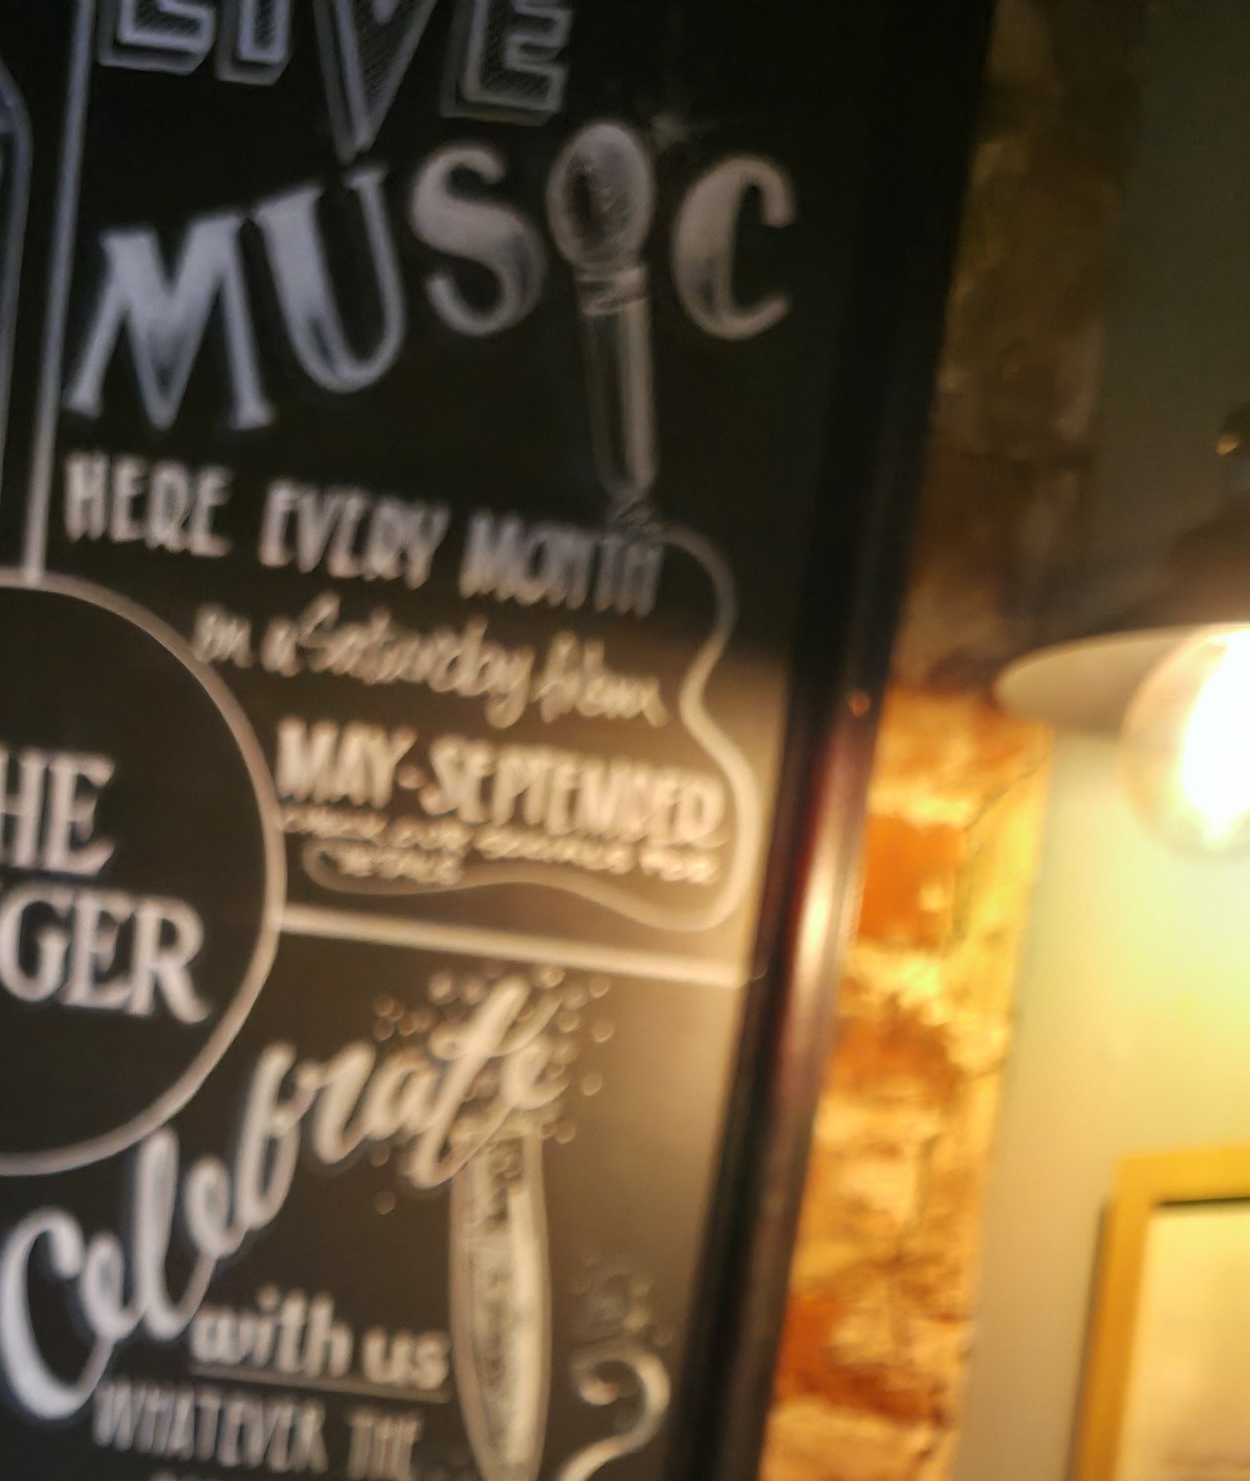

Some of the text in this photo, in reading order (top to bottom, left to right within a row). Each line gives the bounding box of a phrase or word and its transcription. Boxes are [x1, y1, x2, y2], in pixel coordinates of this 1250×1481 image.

[65, 453, 664, 618] HERE EVERY MONTH
[189, 1285, 451, 1390] with us
[91, 1377, 330, 1474] WHATEVER
